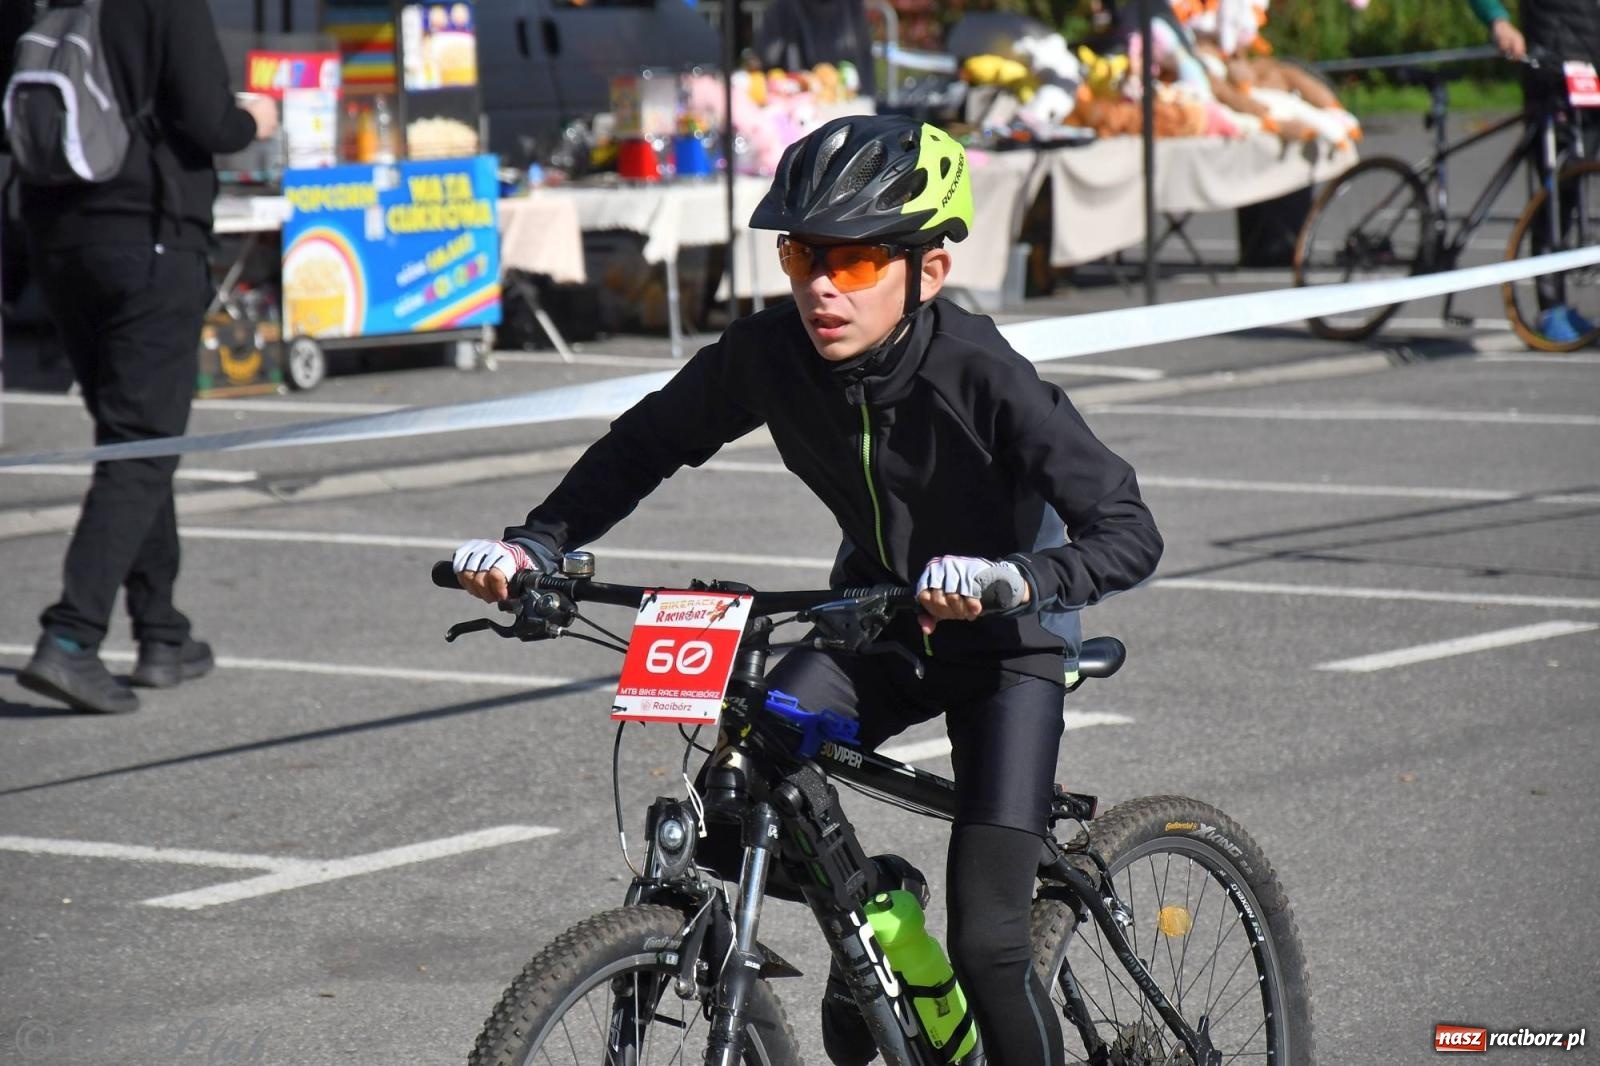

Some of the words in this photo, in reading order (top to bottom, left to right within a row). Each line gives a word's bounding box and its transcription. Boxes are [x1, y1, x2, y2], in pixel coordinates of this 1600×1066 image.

[645, 639, 714, 675] 60
[620, 687, 638, 695] MTB
[638, 688, 657, 696] BIKE
[657, 689, 680, 697] RACE
[652, 701, 693, 711] Racibórz
[833, 743, 863, 769] VIPER
